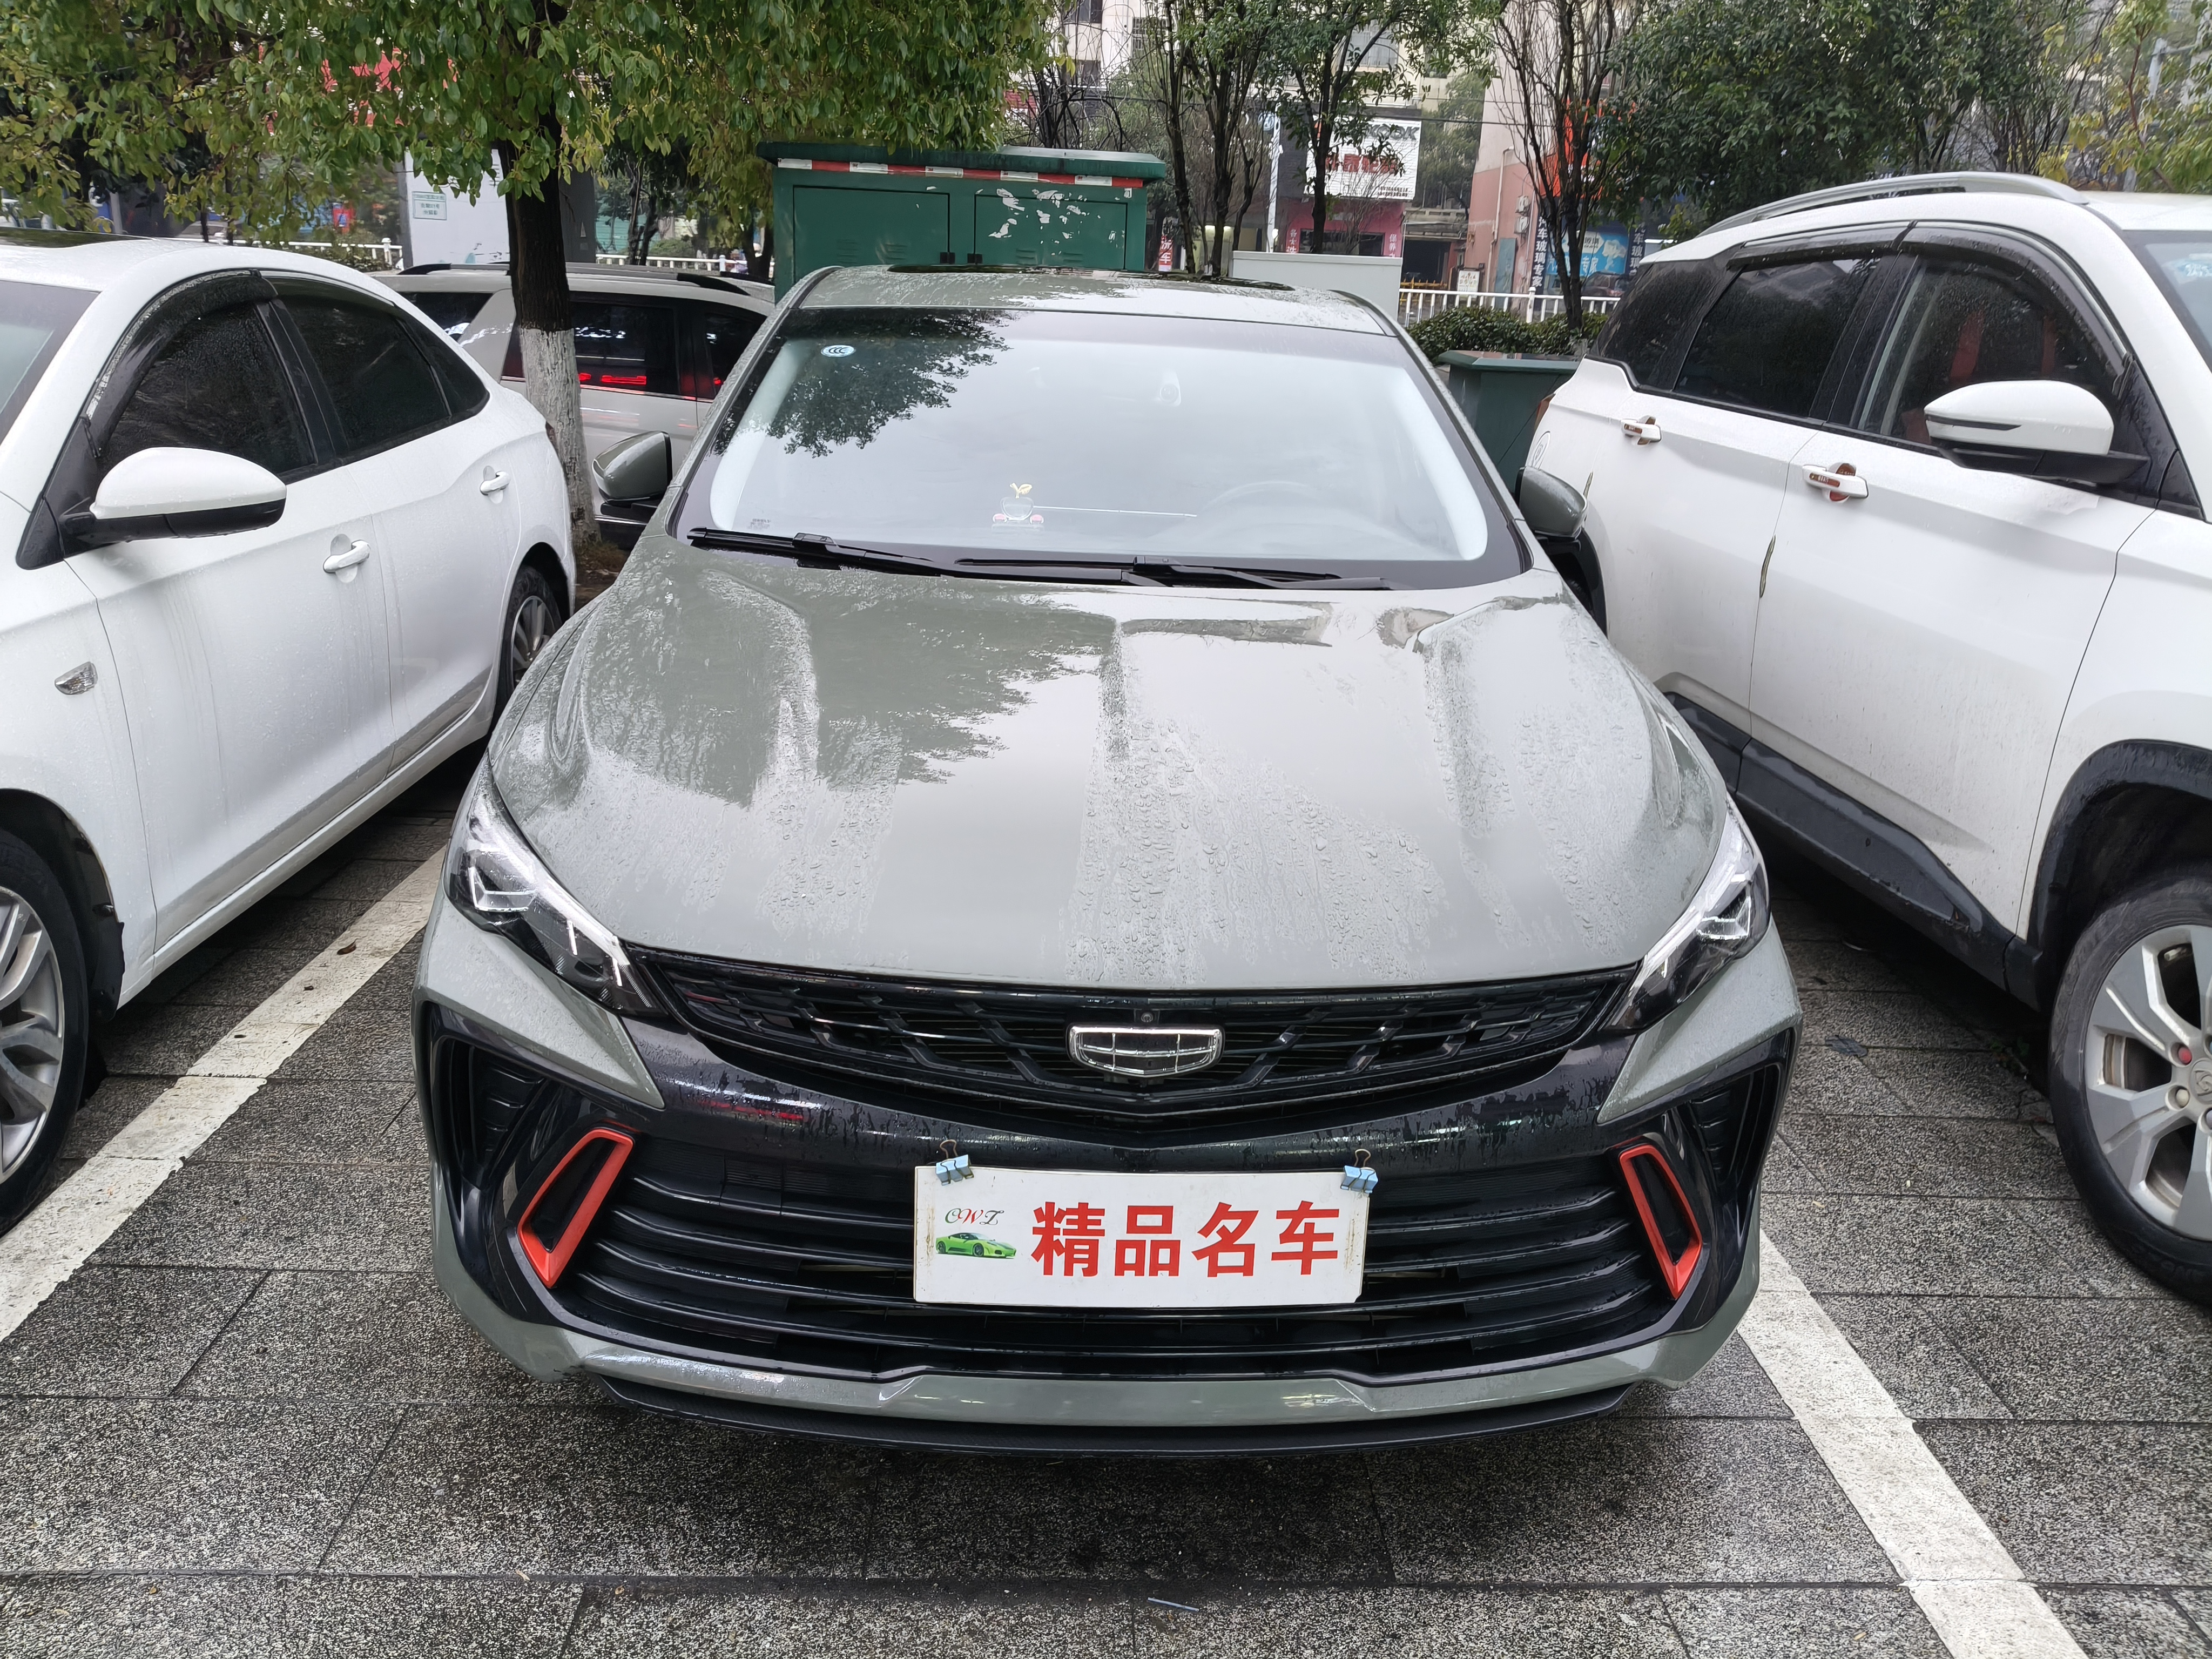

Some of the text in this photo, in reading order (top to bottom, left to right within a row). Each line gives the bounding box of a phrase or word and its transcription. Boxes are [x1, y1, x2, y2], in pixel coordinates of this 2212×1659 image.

[1159, 238, 1172, 264] 洗车
[1532, 216, 1548, 287] 汽车玻璃专家
[1031, 1200, 1339, 1277] 精品名车
